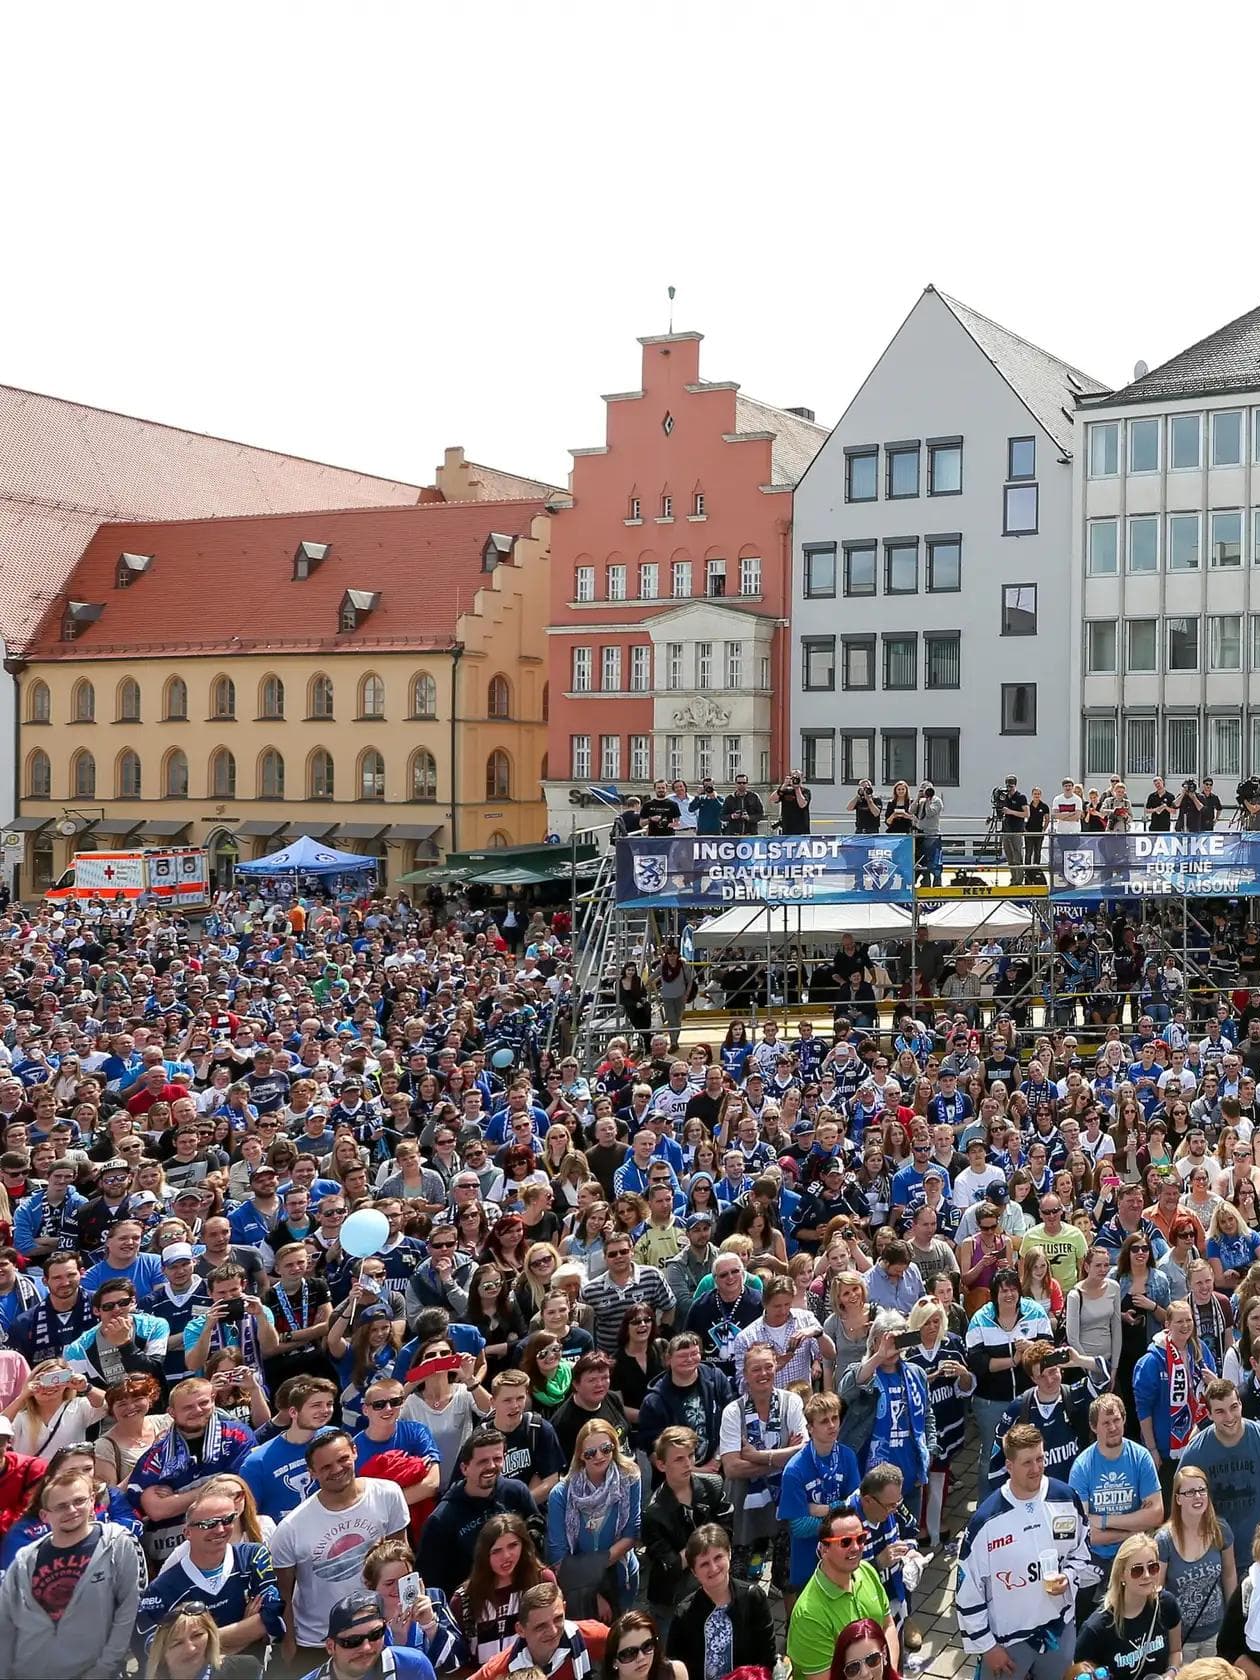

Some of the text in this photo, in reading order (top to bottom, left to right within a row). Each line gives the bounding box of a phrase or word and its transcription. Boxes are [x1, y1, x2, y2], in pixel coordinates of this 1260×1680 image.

[693, 841, 842, 860] INGOLSTADT
[1135, 836, 1225, 857] DANKE
[709, 864, 827, 880] GRATULIERT
[1147, 861, 1213, 874] FÜR EINE
[722, 884, 761, 900] DEM
[1123, 878, 1240, 896] TOLLE SAISON!
[1093, 1489, 1133, 1506] DENIM
